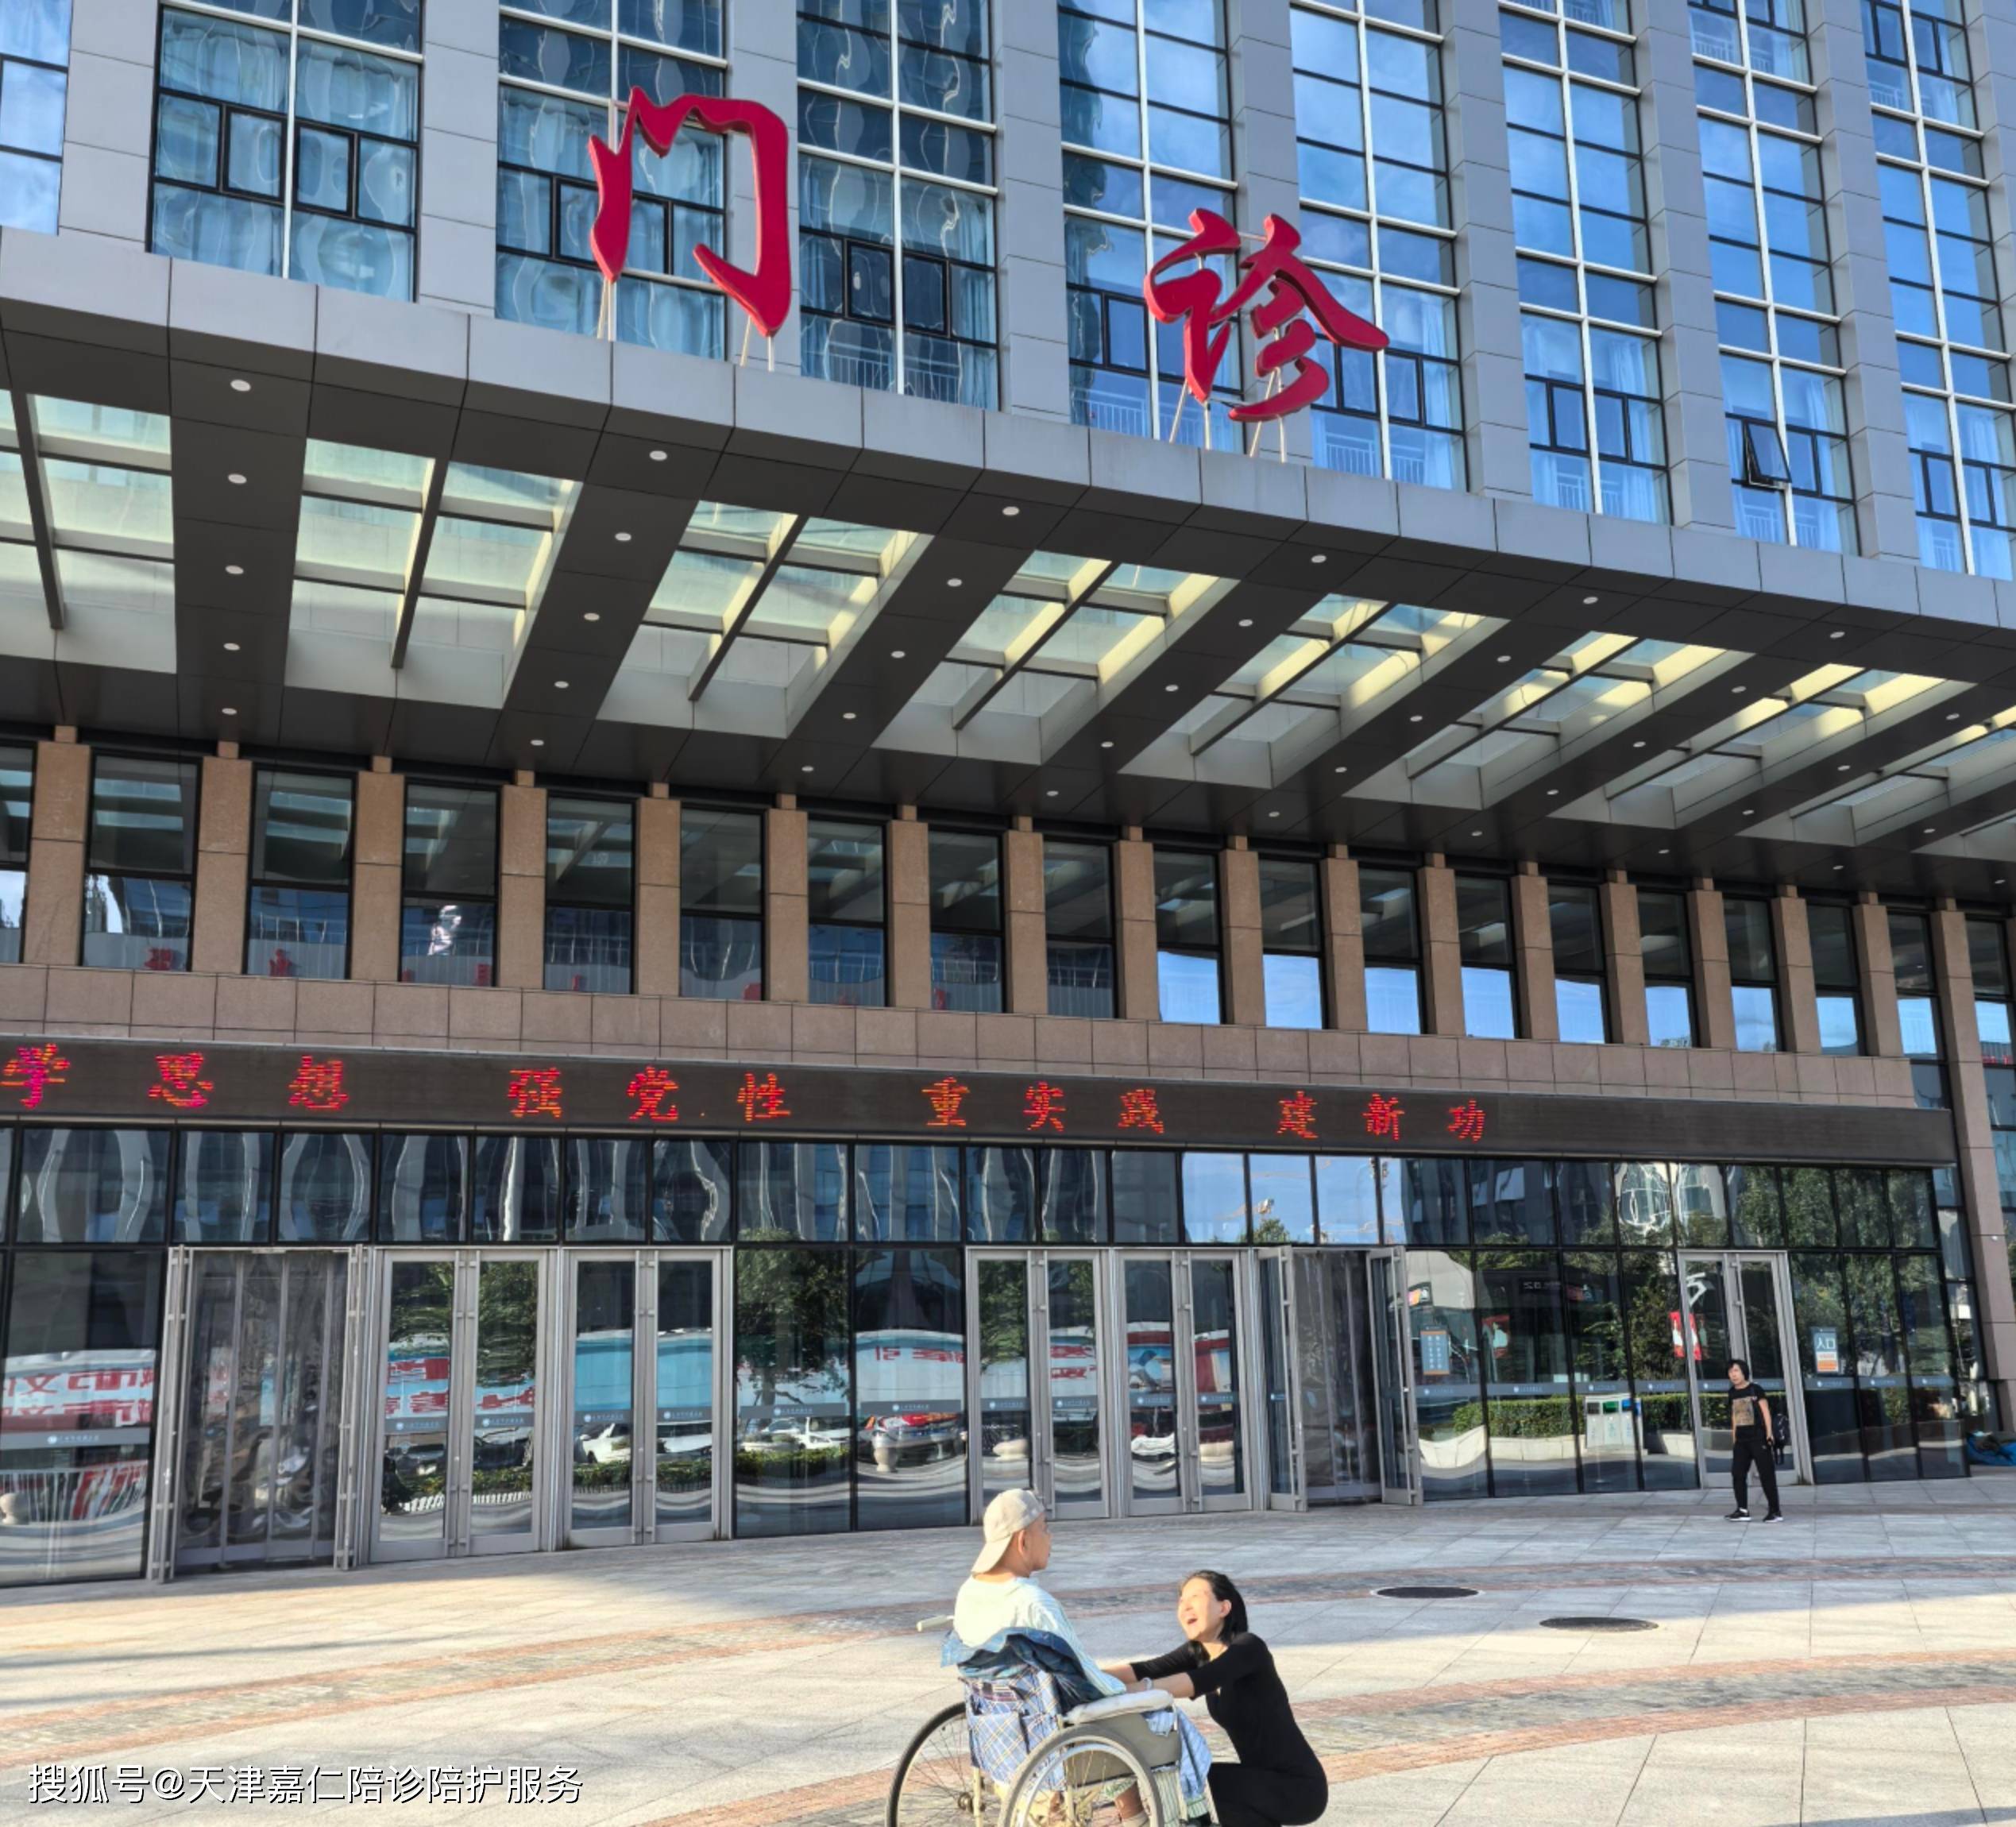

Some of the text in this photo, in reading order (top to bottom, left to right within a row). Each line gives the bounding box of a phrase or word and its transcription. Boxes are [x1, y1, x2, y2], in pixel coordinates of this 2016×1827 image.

[588, 87, 1388, 421] 门诊
[1, 1042, 1485, 1142] 学思想 强党性 重实践 建新功
[1817, 1336, 1836, 1350] 入口
